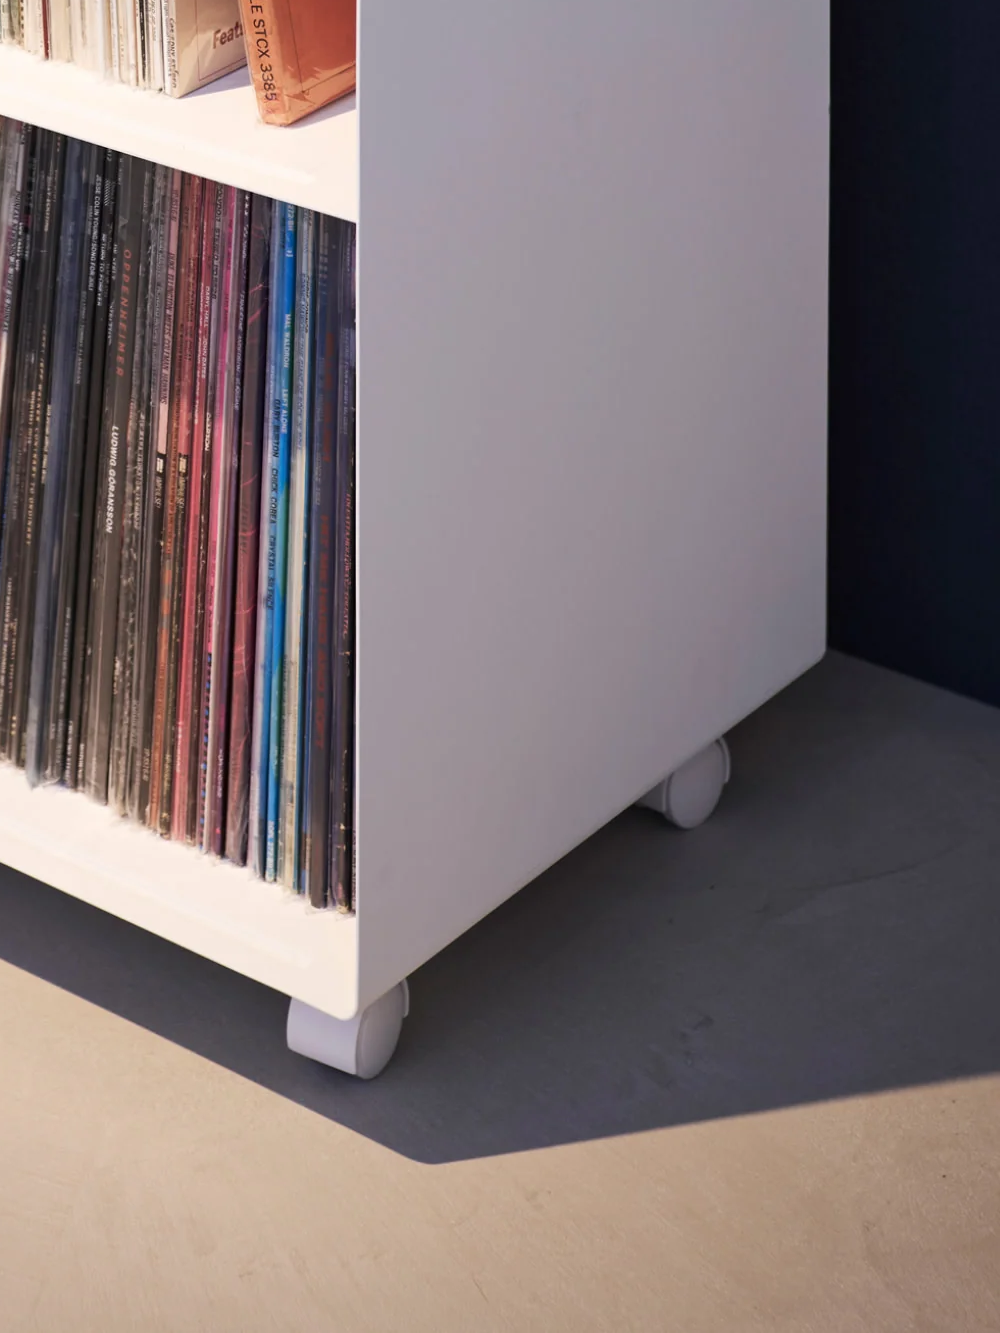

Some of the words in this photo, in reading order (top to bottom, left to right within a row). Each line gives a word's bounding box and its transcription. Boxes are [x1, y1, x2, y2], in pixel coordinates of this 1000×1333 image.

[253, 19, 271, 59] STCX
[259, 63, 277, 102] 3385
[94, 174, 102, 195] JESSE
[93, 195, 101, 216] COLIN
[90, 216, 100, 262] YOUNG/SONG
[99, 233, 108, 261] RETURN
[212, 227, 222, 260] STEREO
[89, 261, 97, 275] FOR
[99, 263, 106, 273] TO
[88, 276, 96, 292] JULI
[96, 274, 105, 307] FOREVER
[203, 286, 211, 310] DARYL
[115, 249, 133, 378] OPPENHEIMER
[163, 314, 173, 336] MEETS
[202, 310, 210, 328] HALL
[283, 313, 291, 329] MAL
[162, 339, 173, 372] COLEMAN
[201, 335, 209, 356] JOHN
[282, 331, 291, 369] WALDRON
[160, 373, 169, 404] HAWKINS
[281, 388, 289, 408] LEFT
[272, 398, 281, 422] GARY
[280, 409, 288, 435] ALONE
[109, 425, 120, 467] LUDWIG
[204, 412, 213, 451] CLAPTON
[271, 424, 281, 458] BURTON
[270, 467, 280, 493] CHICK
[105, 468, 117, 534] GÖRANSSON
[269, 496, 278, 525] COREA
[320, 514, 329, 548] HIT
[268, 534, 277, 571] CRYSTAL
[319, 552, 329, 580] ME
[266, 576, 276, 611] SILENCE
[317, 587, 329, 644] HARD
[317, 648, 327, 673] AND
[315, 697, 326, 750] SOFT
